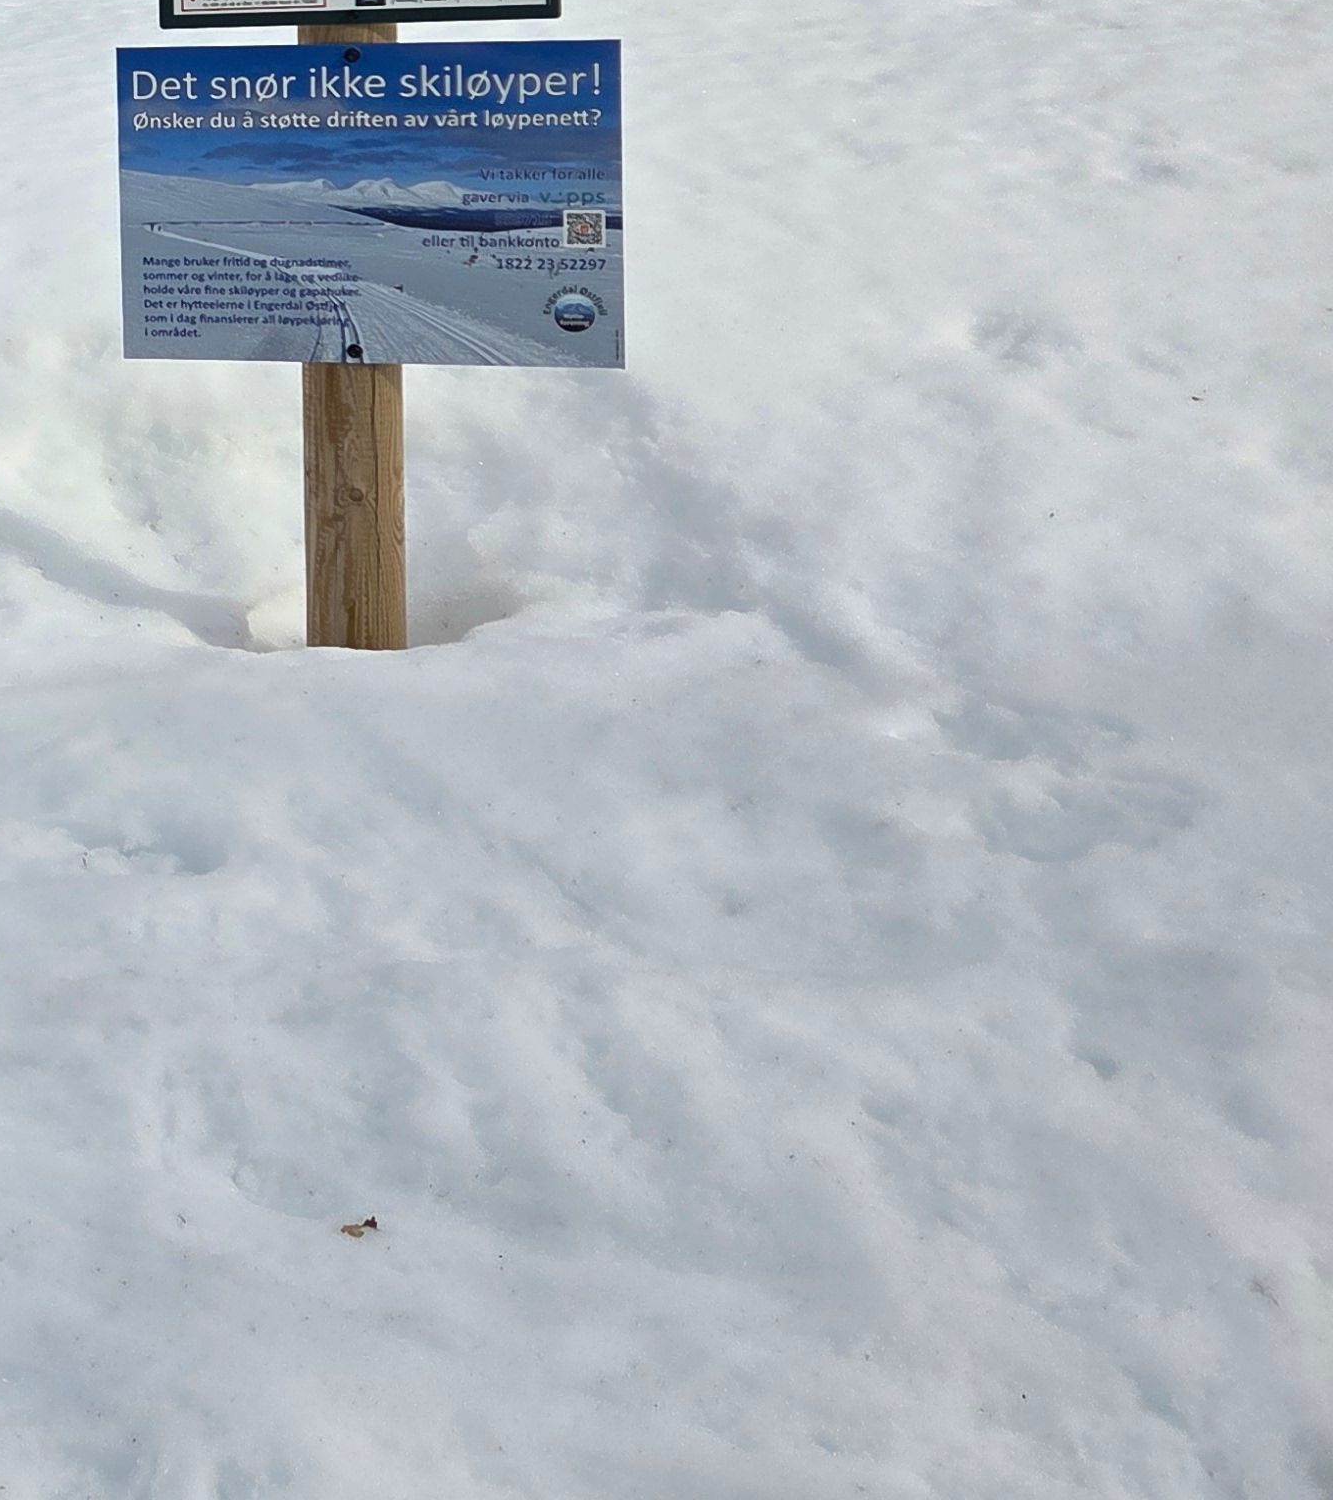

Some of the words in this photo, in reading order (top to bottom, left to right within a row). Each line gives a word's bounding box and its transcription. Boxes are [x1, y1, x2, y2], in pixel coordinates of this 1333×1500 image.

[132, 70, 198, 100] Det
[210, 72, 296, 102] snør
[309, 65, 386, 99] ikke
[399, 62, 601, 105] skiløyper!
[133, 111, 204, 132] Ønsker
[210, 112, 236, 129] du
[242, 111, 254, 128] å
[260, 112, 321, 129] støtte
[326, 110, 397, 128] driften
[404, 113, 429, 128] av
[434, 108, 477, 127] vårt
[484, 108, 602, 130] løypenett?
[480, 168, 495, 181] Vi
[499, 168, 546, 181] takker
[552, 168, 573, 180] for
[577, 168, 606, 180] alle
[462, 192, 503, 206] gaver
[508, 191, 530, 204] via
[422, 235, 455, 248] eller
[459, 235, 475, 248] til
[479, 235, 560, 248] bankkonto
[142, 257, 181, 268] Mange
[184, 256, 220, 266] bruker
[223, 257, 251, 266] fritid
[253, 259, 267, 268] og
[496, 257, 533, 270] 1822
[537, 257, 555, 271] 23
[560, 257, 606, 270] 52297
[143, 272, 188, 280] sommer
[191, 273, 205, 282] og
[207, 271, 243, 282] vinter,
[246, 270, 262, 280] for
[266, 271, 272, 280] å
[274, 271, 298, 283] lage
[301, 274, 314, 283] og
[143, 284, 175, 294] holde
[177, 284, 201, 294] våre
[204, 284, 226, 294] fine
[228, 285, 279, 297] skiløyper
[283, 288, 296, 297] og
[144, 299, 163, 309] Det
[166, 301, 178, 309] er
[180, 299, 245, 311] hytteeierne
[254, 300, 303, 311] Engerdal
[144, 315, 167, 323] som
[177, 313, 197, 325] dag
[199, 313, 259, 324] finansierer
[262, 314, 275, 324] all
[151, 326, 201, 337] området.
